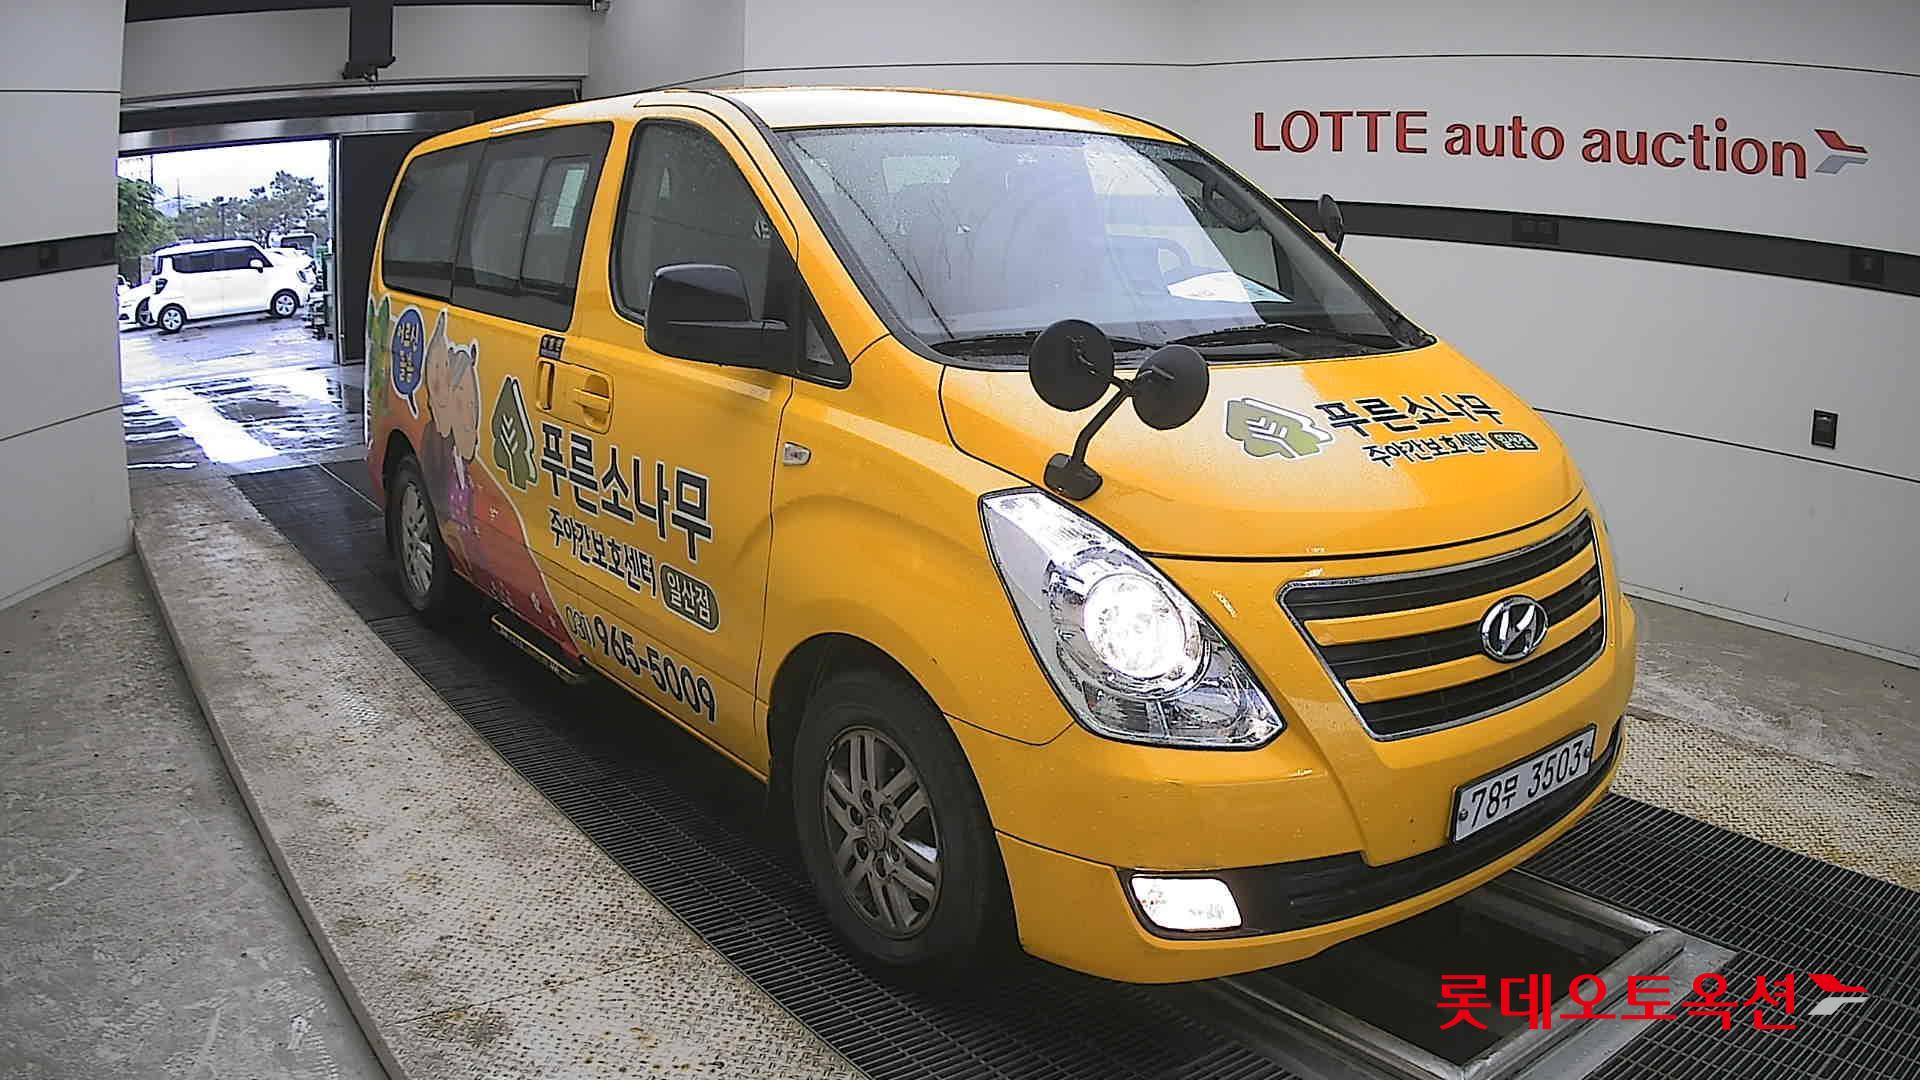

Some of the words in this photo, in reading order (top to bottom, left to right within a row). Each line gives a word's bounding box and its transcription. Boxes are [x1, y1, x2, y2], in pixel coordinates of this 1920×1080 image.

[1254, 110, 1428, 154] LOTTE
[1444, 115, 1566, 160] auto
[1581, 118, 1808, 179] auction
[1315, 393, 1504, 437] 푸른소나무
[1362, 432, 1494, 467] 주야간보호센터
[1494, 433, 1536, 449] 일산점
[541, 422, 713, 562] 푸른소나무
[550, 508, 657, 597] 주야간보호센터
[666, 571, 711, 623] 일산점
[594, 615, 716, 723] 965-5009
[1471, 774, 1518, 828] 78무
[1528, 740, 1584, 798] 3503
